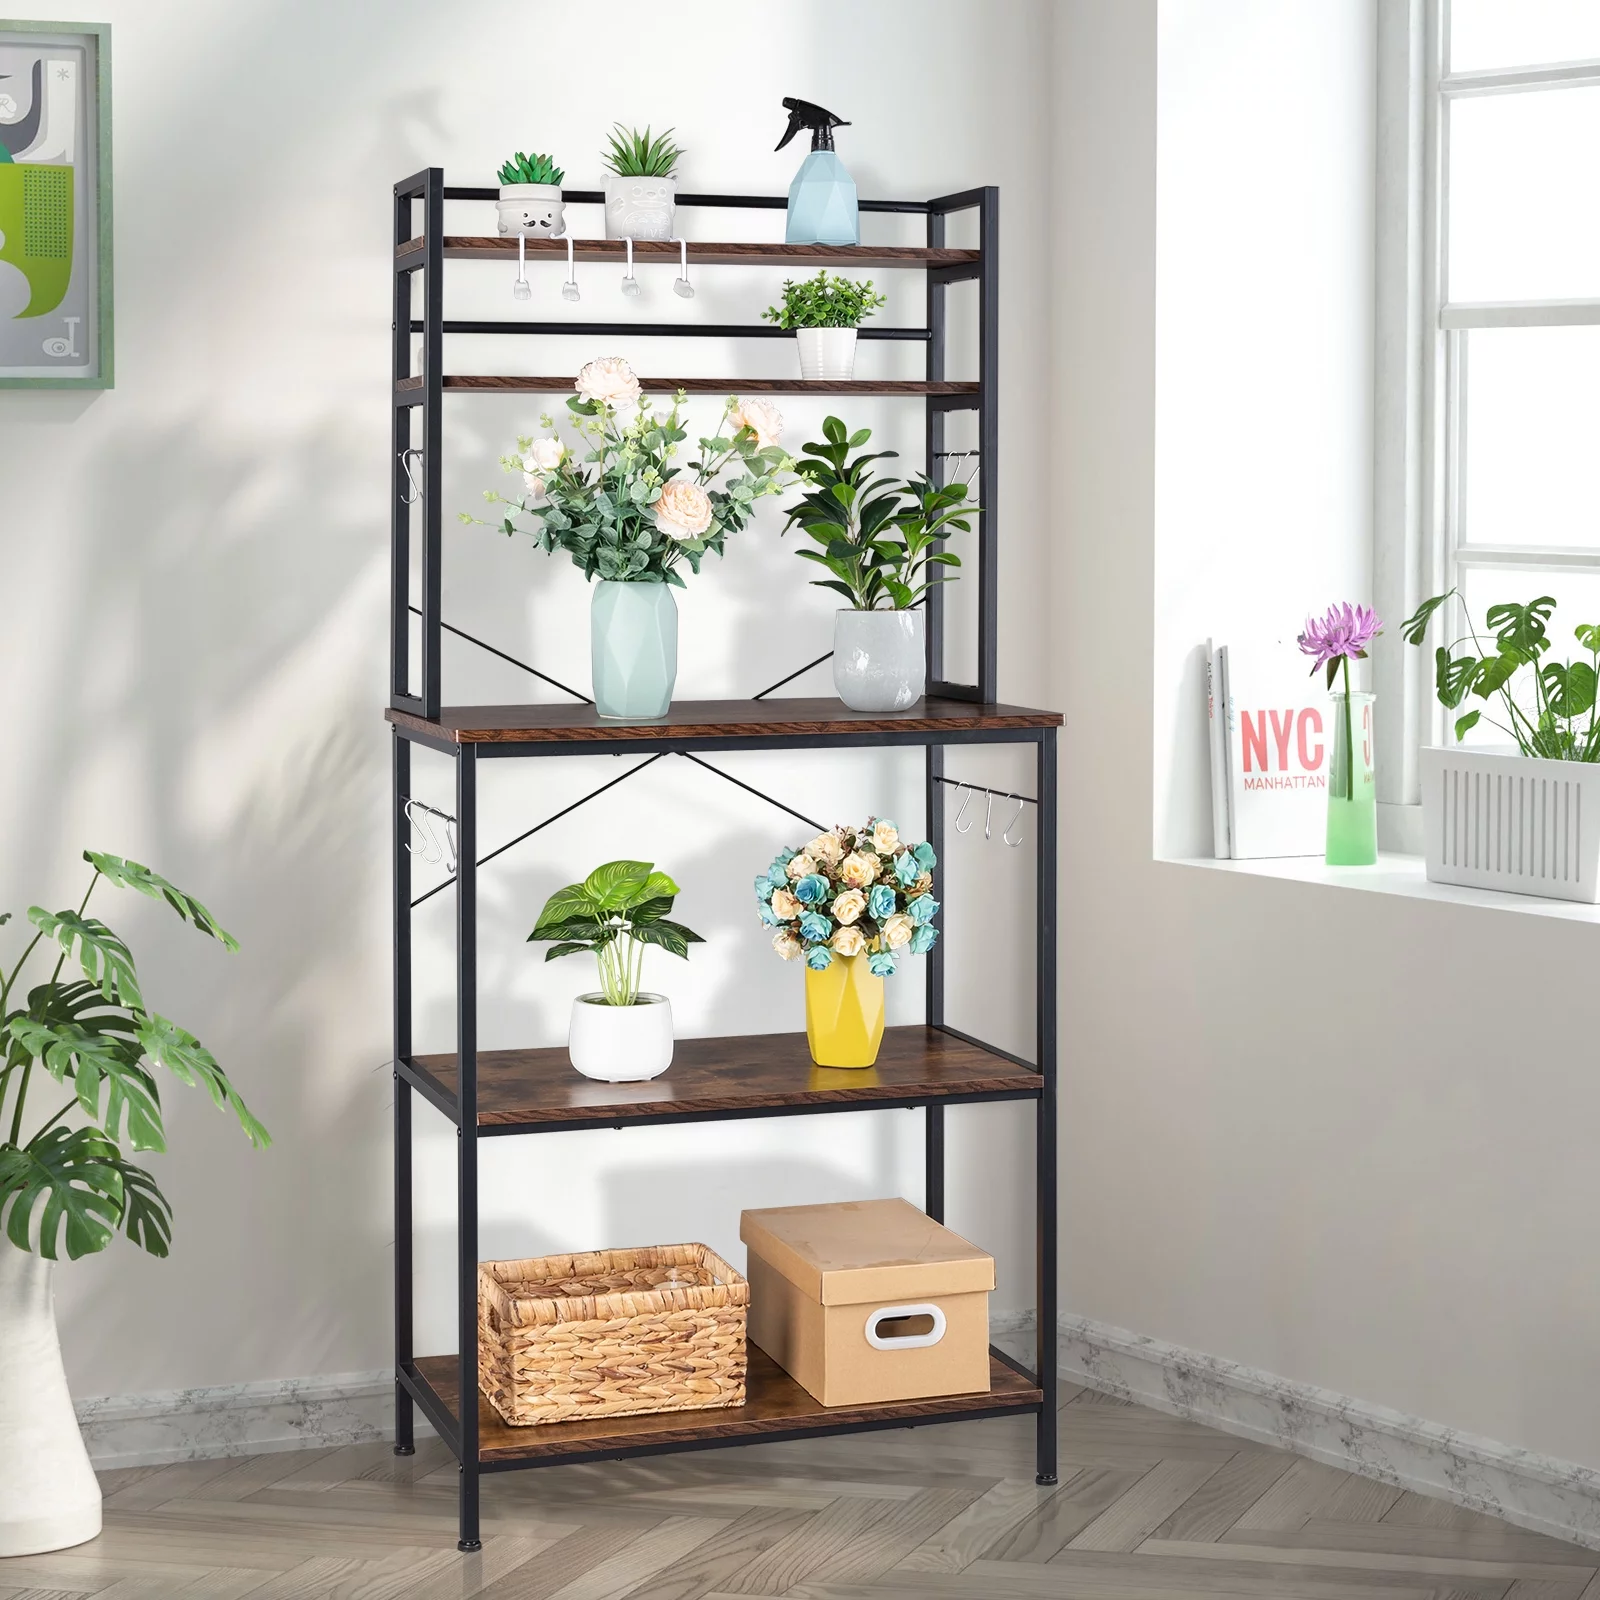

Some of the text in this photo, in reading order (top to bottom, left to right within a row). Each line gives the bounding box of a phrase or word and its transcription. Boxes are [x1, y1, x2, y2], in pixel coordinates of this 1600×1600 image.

[633, 227, 665, 239] LIVE
[1240, 707, 1324, 773] NYC
[1244, 775, 1325, 790] MANHATTAN
